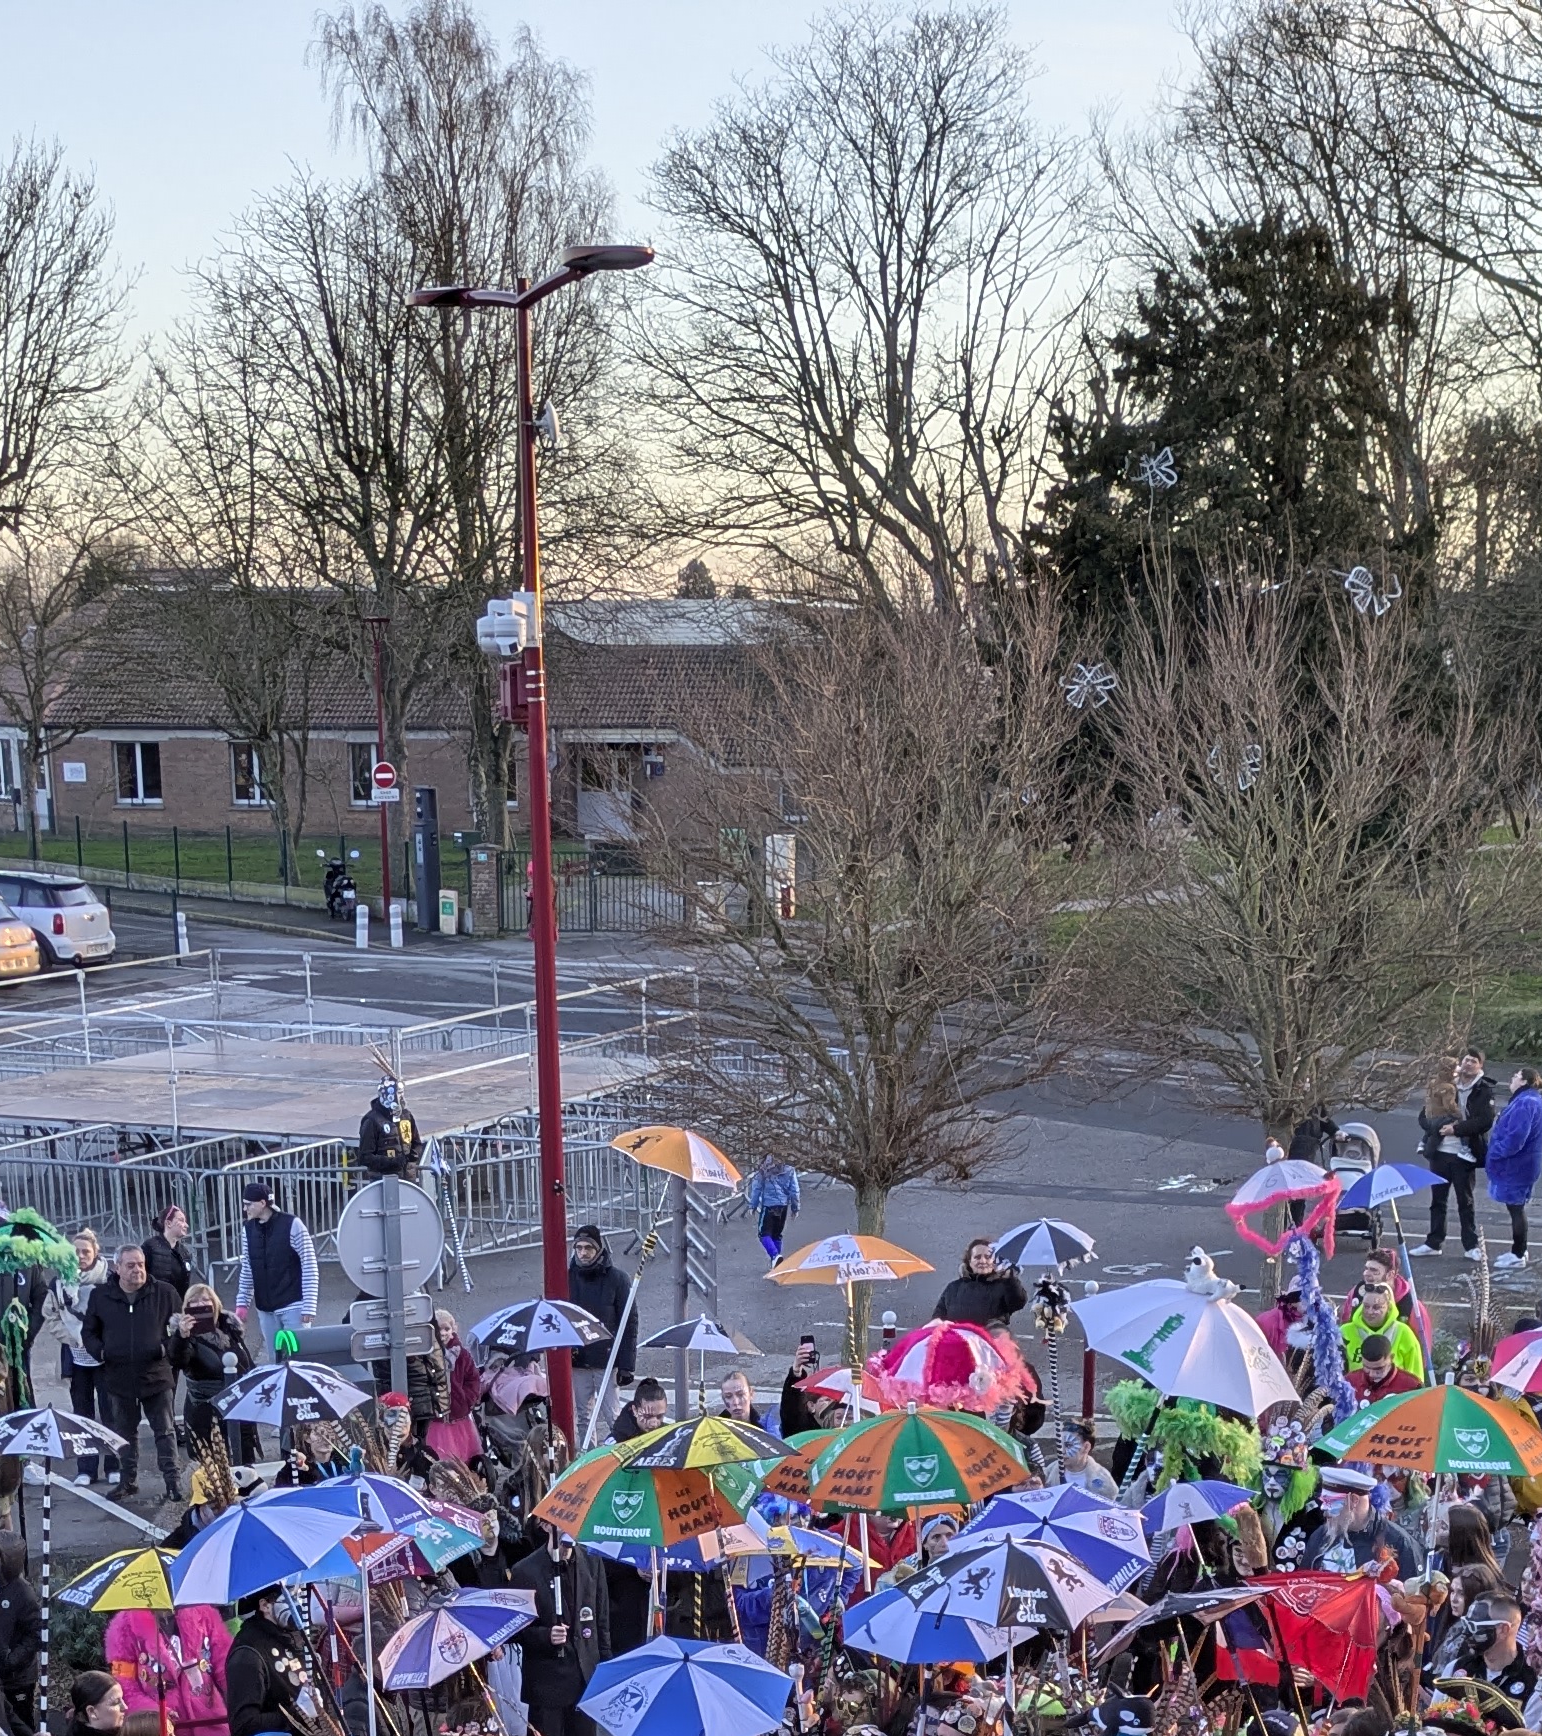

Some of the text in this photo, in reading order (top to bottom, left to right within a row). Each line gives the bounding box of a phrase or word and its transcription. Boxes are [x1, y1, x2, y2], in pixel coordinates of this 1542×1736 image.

[1370, 1434, 1432, 1447] HOUT'
[1367, 1449, 1424, 1460] MANS
[1448, 1460, 1511, 1470] HOUTKERQUE
[830, 1485, 873, 1496] MANS
[593, 1525, 650, 1538] HOUTKERQUE
[680, 1517, 717, 1534] MAN
[1106, 1558, 1141, 1594] OYMILLE
